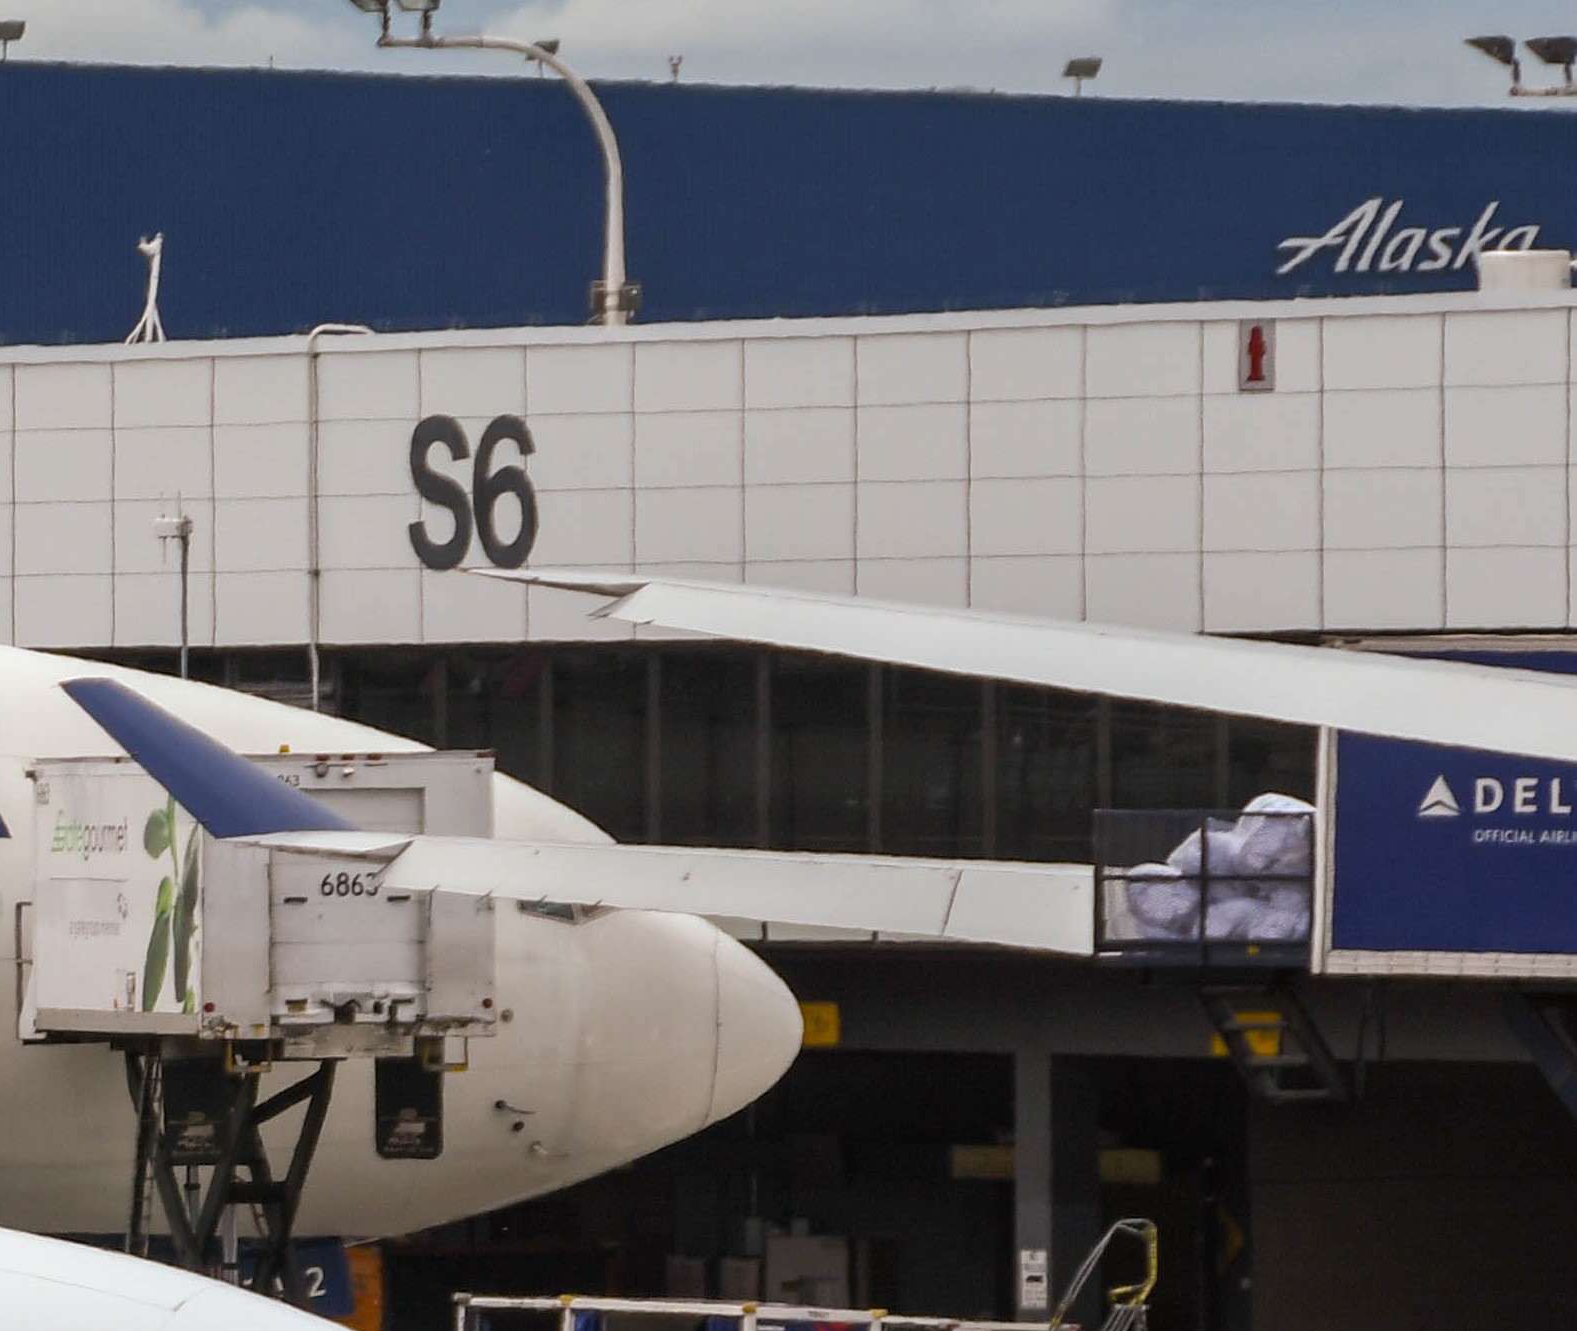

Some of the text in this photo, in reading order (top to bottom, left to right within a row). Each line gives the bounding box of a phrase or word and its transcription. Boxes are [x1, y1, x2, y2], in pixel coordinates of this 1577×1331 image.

[408, 414, 538, 569] S6
[1474, 777, 1573, 814] DEL
[1474, 829, 1535, 843] OFFICIAL
[321, 871, 383, 896] 6863
